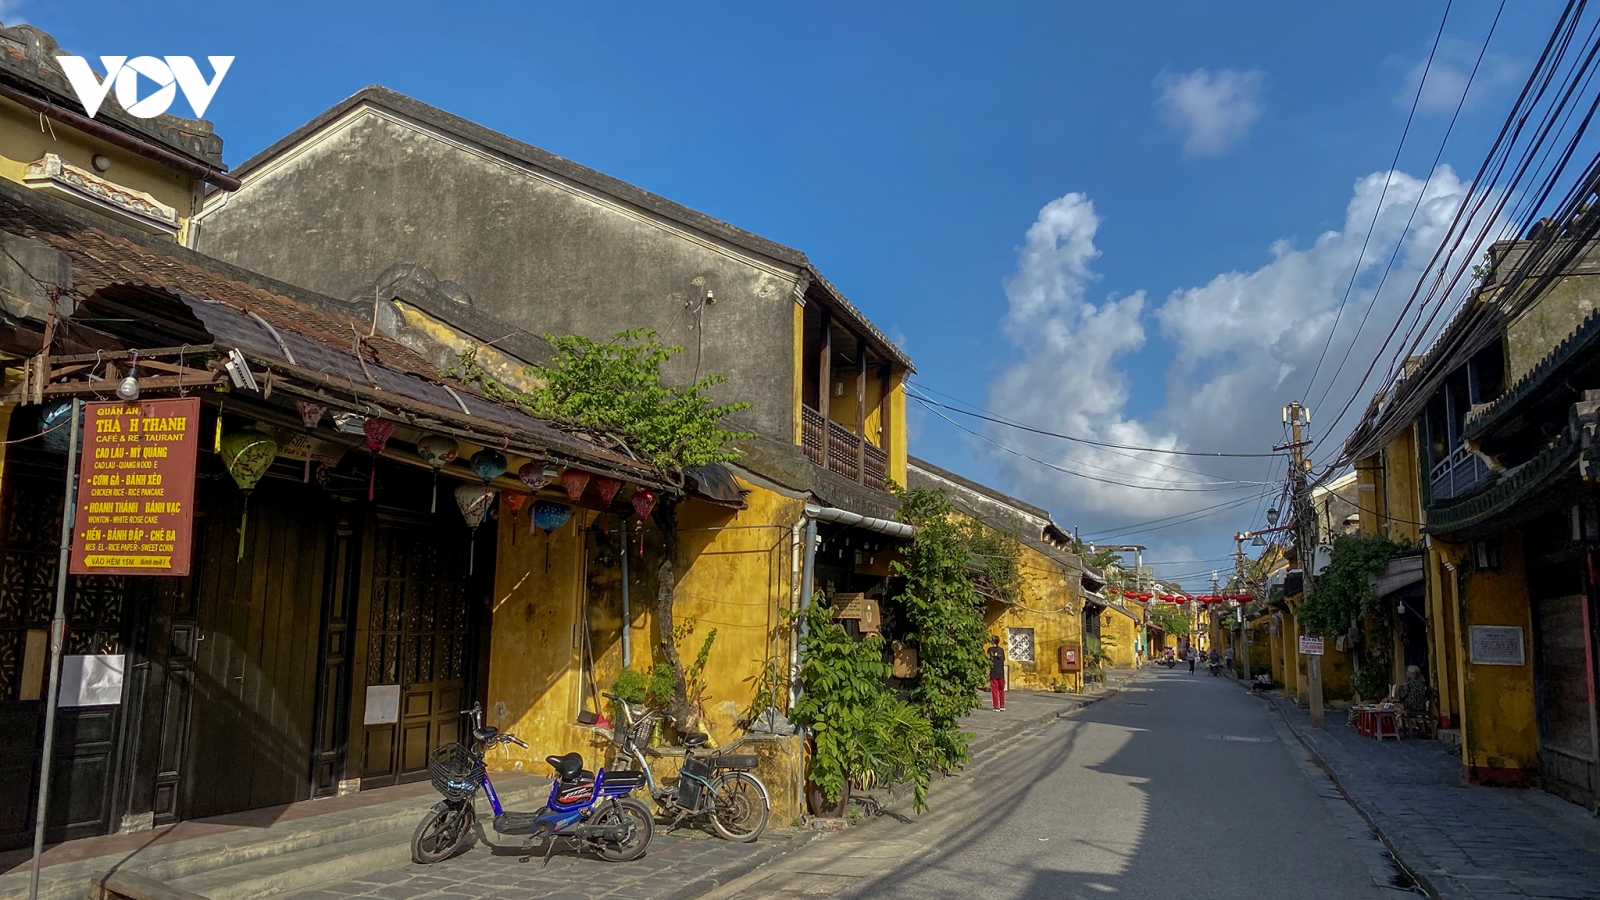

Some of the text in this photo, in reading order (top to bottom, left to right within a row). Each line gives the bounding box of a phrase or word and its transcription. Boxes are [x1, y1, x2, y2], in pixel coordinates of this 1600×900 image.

[97, 406, 123, 416] QUÁN
[142, 418, 186, 432] THANH
[95, 448, 109, 458] CAO
[143, 444, 167, 459] QUẢNG
[93, 474, 109, 486] CƠM
[126, 472, 146, 485] BÁNH
[89, 500, 181, 515] HOANH THÁNH BÁNH VẠC
[107, 527, 127, 540] BÁNH
